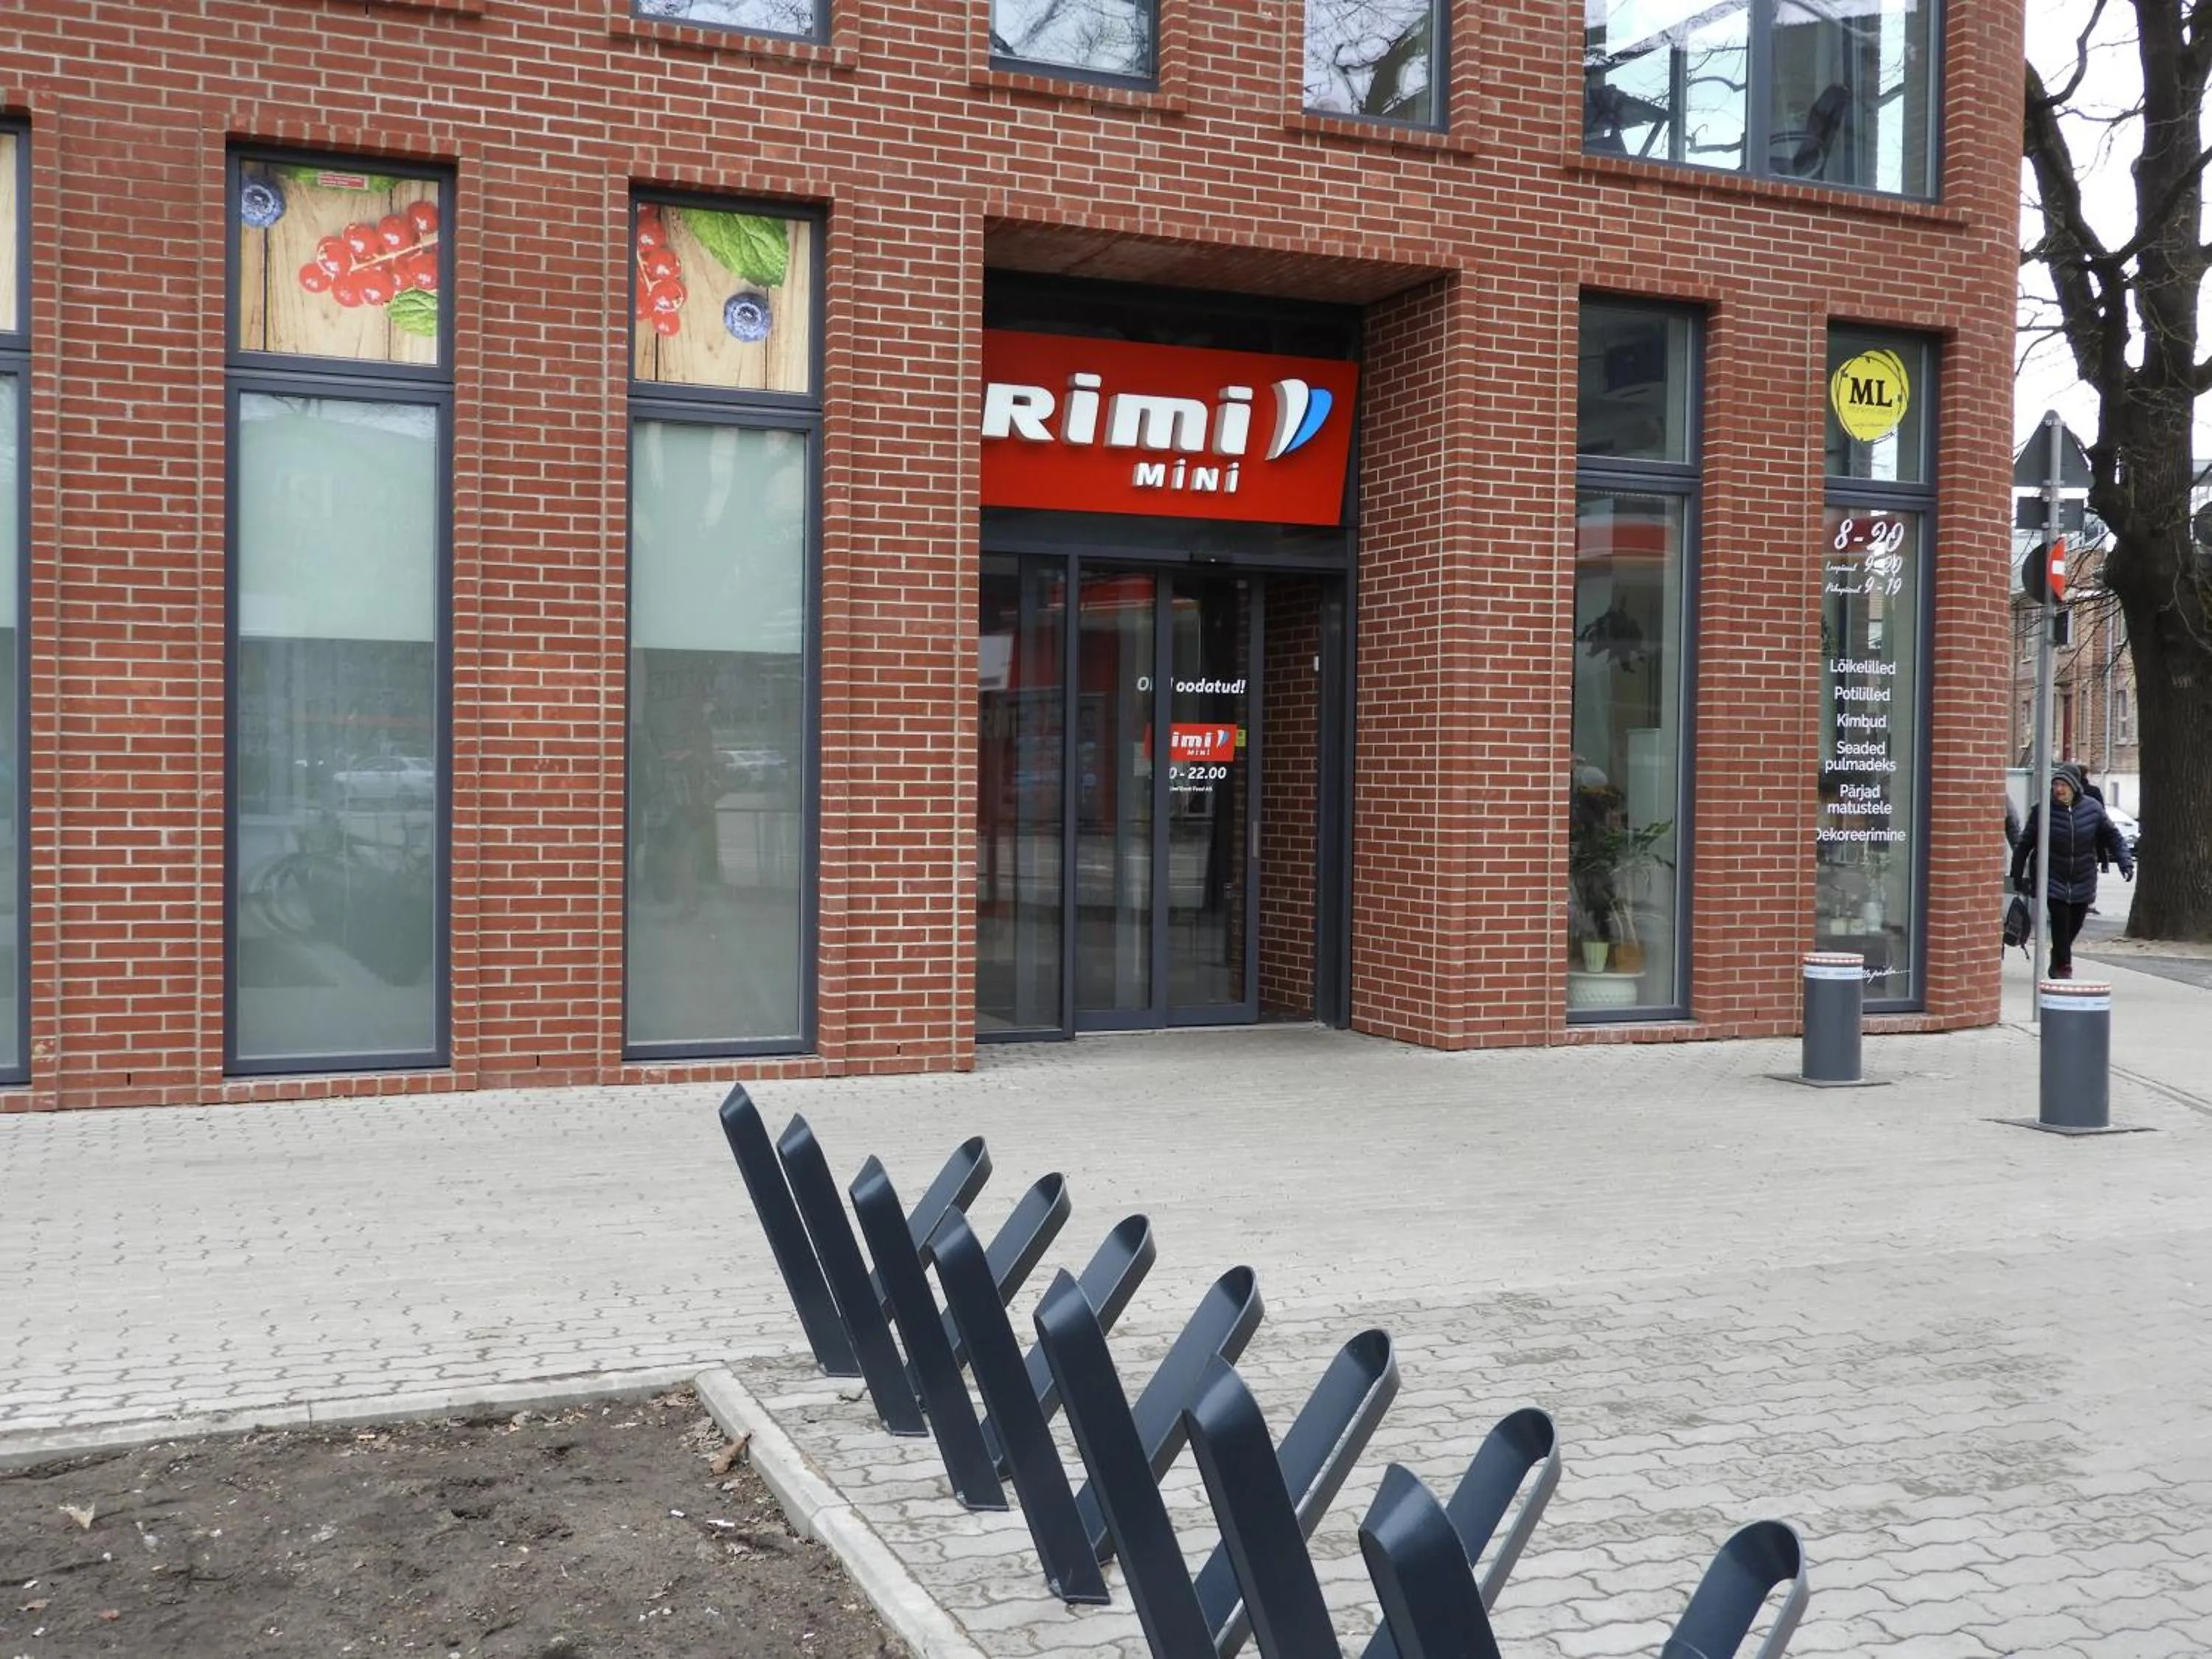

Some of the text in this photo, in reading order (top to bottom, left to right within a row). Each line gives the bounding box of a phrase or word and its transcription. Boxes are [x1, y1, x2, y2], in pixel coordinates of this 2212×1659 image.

[1849, 377, 1893, 407] ML
[981, 373, 1253, 456] Rimi
[1834, 518, 1853, 549] 8
[1866, 521, 1904, 552] 20
[1865, 577, 1874, 594] 9
[1885, 577, 1902, 595] 19
[1829, 658, 1896, 675] Lõikelilled
[1176, 678, 1246, 694] oodatud!
[1834, 686, 1891, 701] Potililled
[1837, 714, 1888, 728] Kimbud
[1171, 731, 1212, 748] imi
[1837, 740, 1886, 756] Seaded
[1188, 766, 1227, 779] 22.00
[1825, 758, 1896, 773] pulmadeks
[1840, 784, 1881, 801] Pärjad
[1827, 800, 1893, 815] matustele
[1816, 827, 1906, 841] Dekoreerimine
